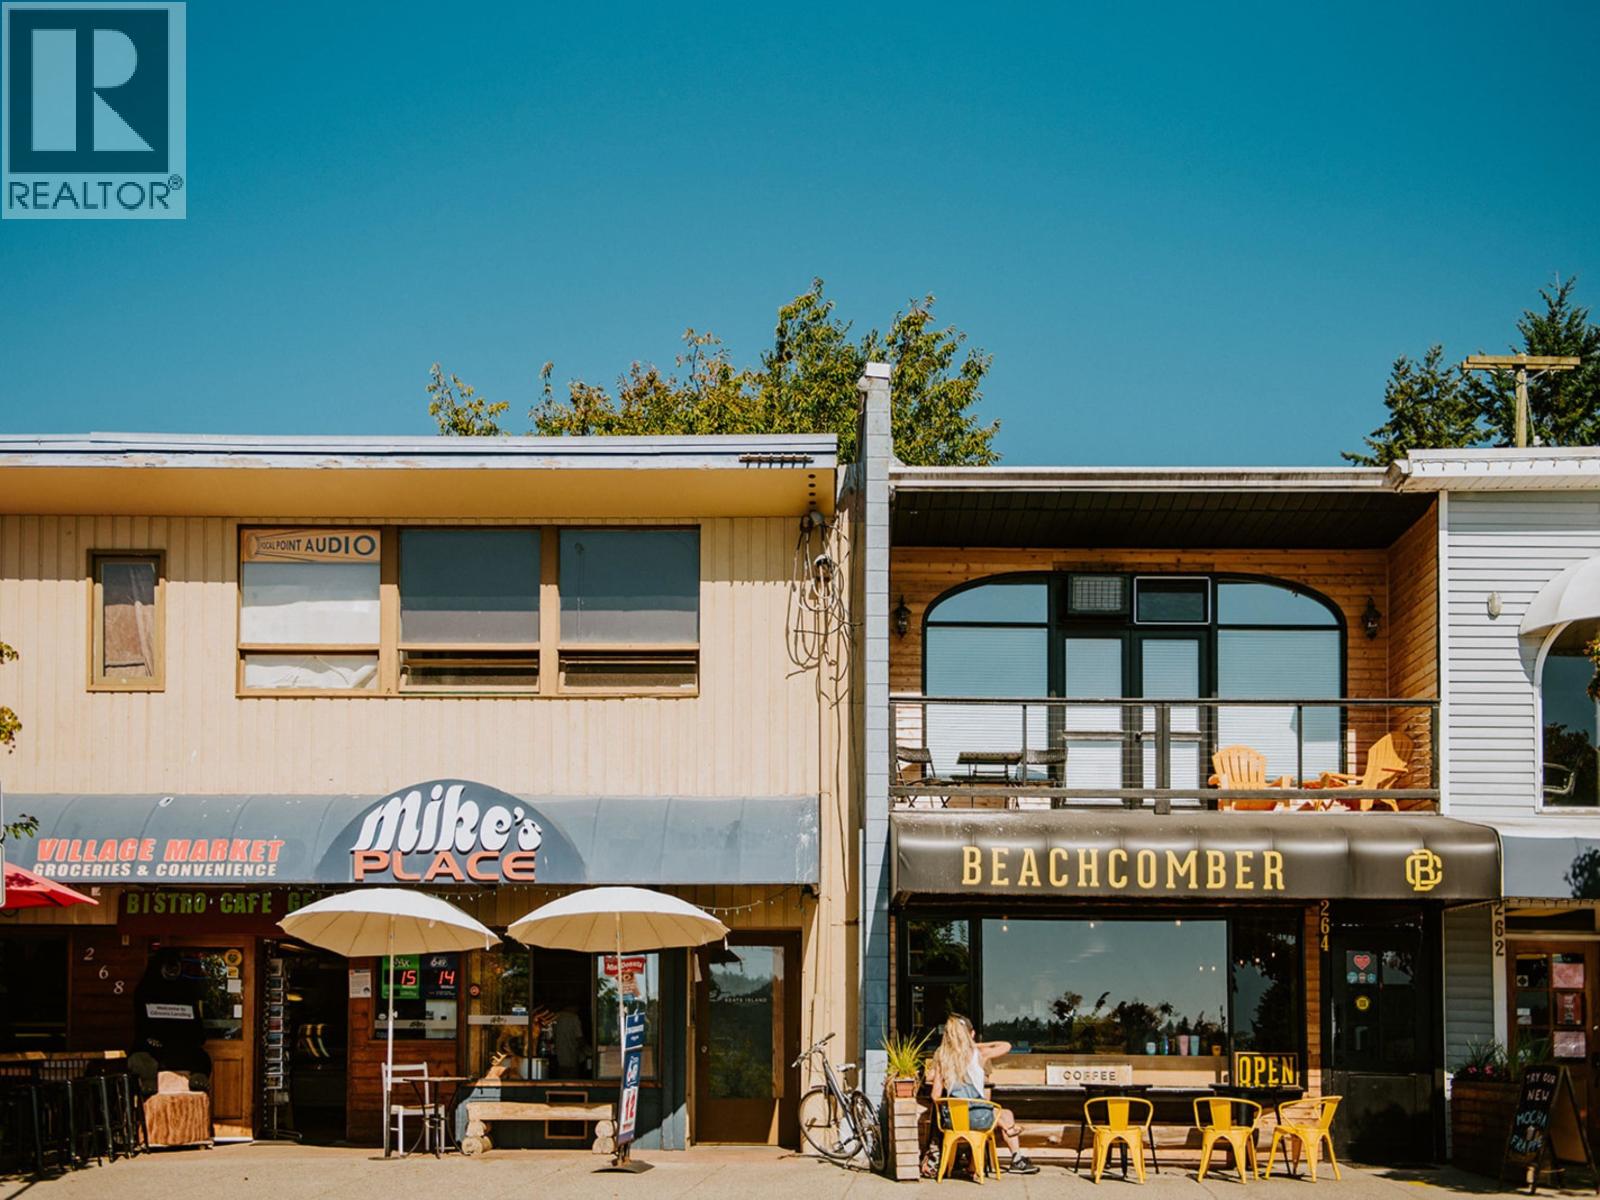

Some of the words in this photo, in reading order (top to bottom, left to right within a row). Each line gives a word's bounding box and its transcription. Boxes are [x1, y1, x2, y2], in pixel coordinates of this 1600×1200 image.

[276, 539, 302, 551] POINT
[304, 535, 376, 556] AUDIO
[350, 784, 543, 853] Mike's
[37, 838, 157, 862] VILLAGE
[163, 839, 285, 863] MARKET
[33, 863, 131, 877] GROCERIES
[136, 864, 149, 877] &
[156, 864, 277, 877] CONVENIENCE
[353, 851, 536, 881] PLACE
[962, 846, 1286, 890] BEACHCOMBER
[126, 892, 207, 914] BISTRO
[401, 970, 416, 985] 15
[438, 970, 455, 985] 14
[1063, 1070, 1116, 1081] COFFEE
[1239, 1055, 1294, 1084] OPEN
[1526, 1072, 1541, 1084] TRY
[1527, 1089, 1550, 1102] NEW
[1517, 1110, 1547, 1128] MOCHA
